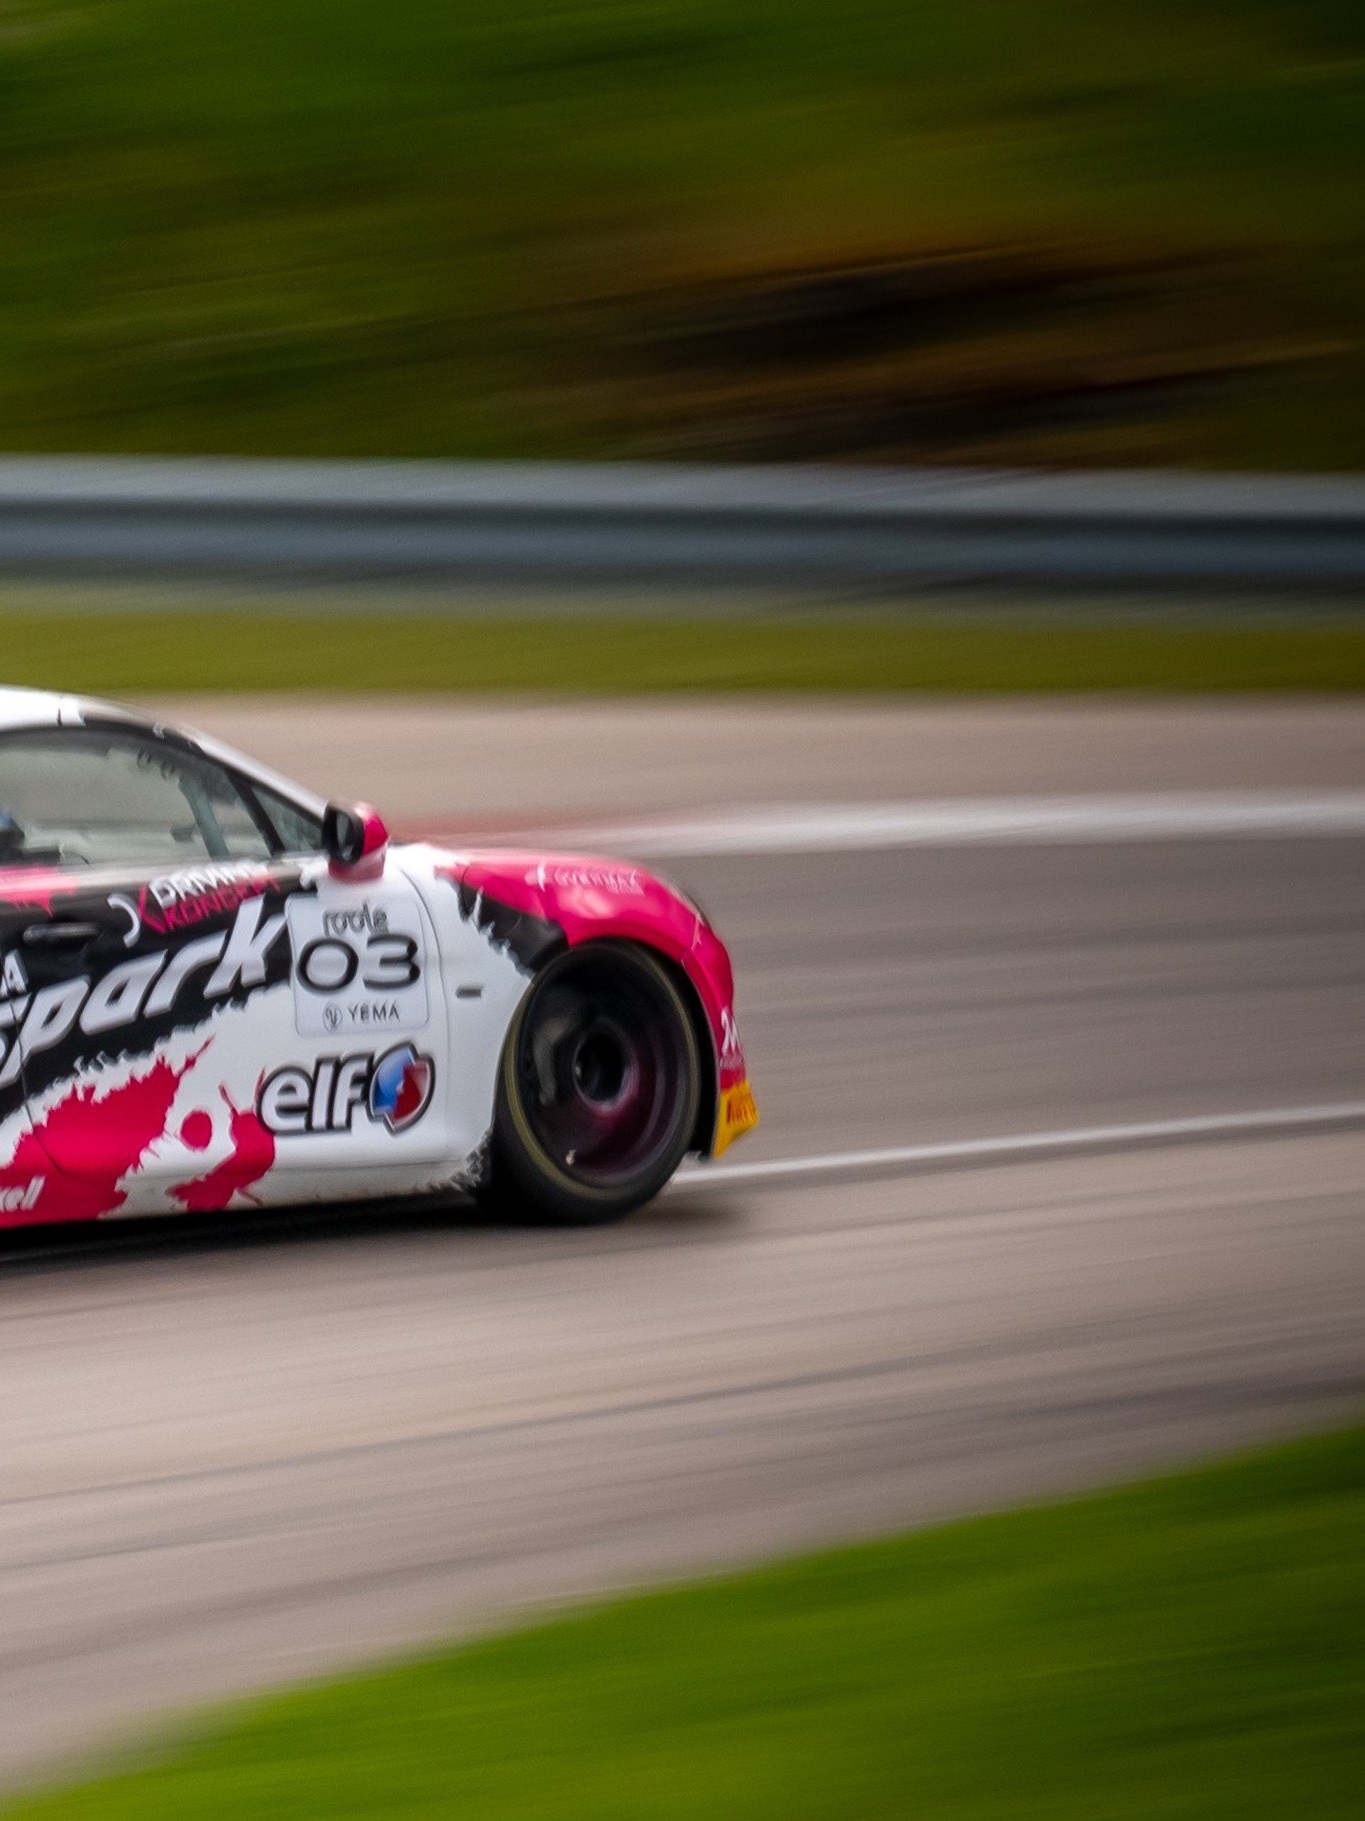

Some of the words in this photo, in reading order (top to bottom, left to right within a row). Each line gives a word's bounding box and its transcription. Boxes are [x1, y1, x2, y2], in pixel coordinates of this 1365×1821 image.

[296, 933, 421, 993] 03
[348, 1003, 400, 1022] YEMA
[256, 1052, 374, 1136] elf
